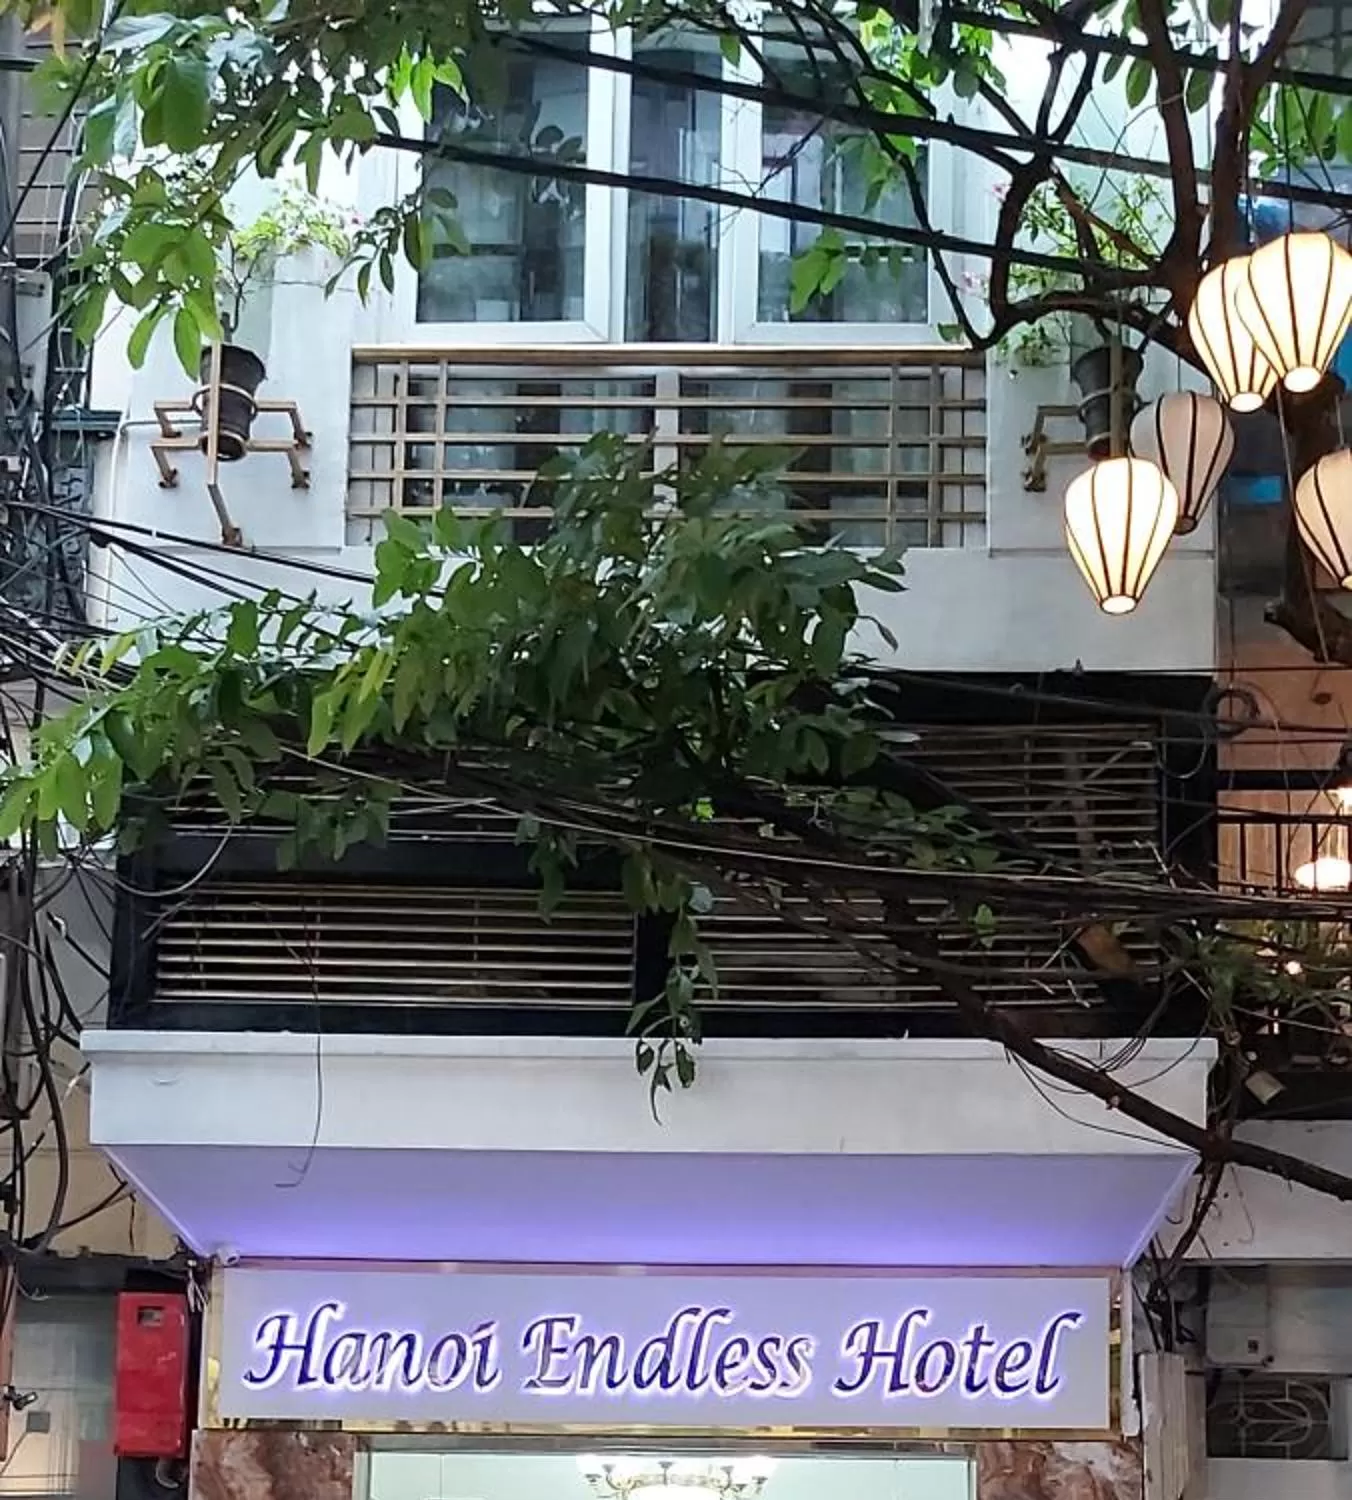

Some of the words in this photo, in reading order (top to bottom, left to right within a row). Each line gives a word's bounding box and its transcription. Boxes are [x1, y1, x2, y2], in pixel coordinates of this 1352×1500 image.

[243, 1302, 500, 1394] Hanoi
[522, 1305, 813, 1396] Endless
[832, 1308, 1084, 1399] Hotel
